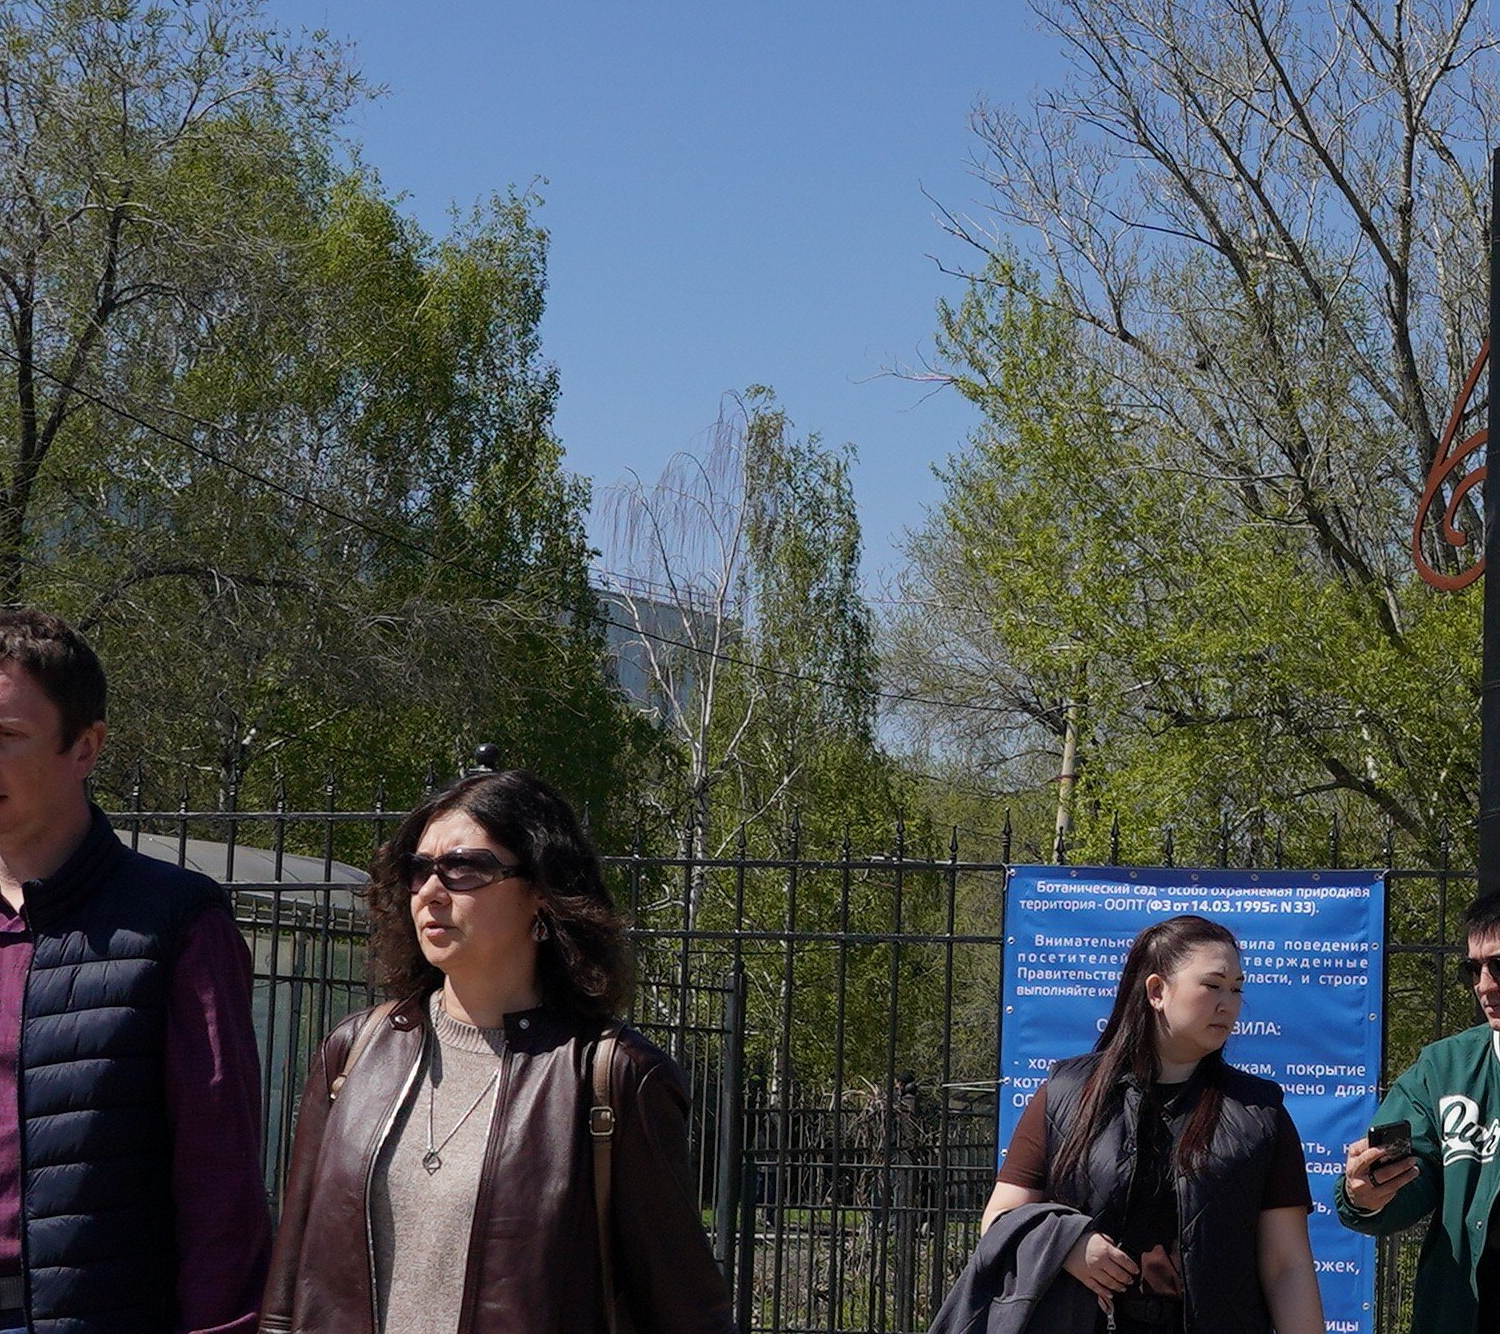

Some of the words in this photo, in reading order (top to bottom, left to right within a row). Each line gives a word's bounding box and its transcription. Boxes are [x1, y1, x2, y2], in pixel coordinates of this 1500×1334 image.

[1037, 881, 1130, 894] Ботанический
[1134, 885, 1157, 896] сад
[1296, 887, 1370, 899] природная
[1020, 900, 1096, 912] территория
[1105, 899, 1146, 911] ООПТ
[1147, 899, 1171, 914] (ФЗ
[1173, 902, 1189, 911] от
[1281, 902, 1292, 912] N
[1294, 903, 1319, 916] 33).
[1236, 940, 1275, 950] вила
[1284, 940, 1368, 952] поведения
[1244, 957, 1368, 967] твержденные
[1242, 971, 1292, 985] бласти,
[1302, 976, 1309, 984] и
[1319, 976, 1368, 986] строго
[1017, 985, 1096, 996] выполняйте
[1098, 988, 1117, 997] их!
[1231, 1021, 1282, 1036] ВИЛА:
[1287, 1064, 1366, 1078] покрытие
[1335, 1085, 1365, 1097] для
[1314, 1261, 1361, 1275] ожек,
[1325, 1320, 1359, 1333] ицы
